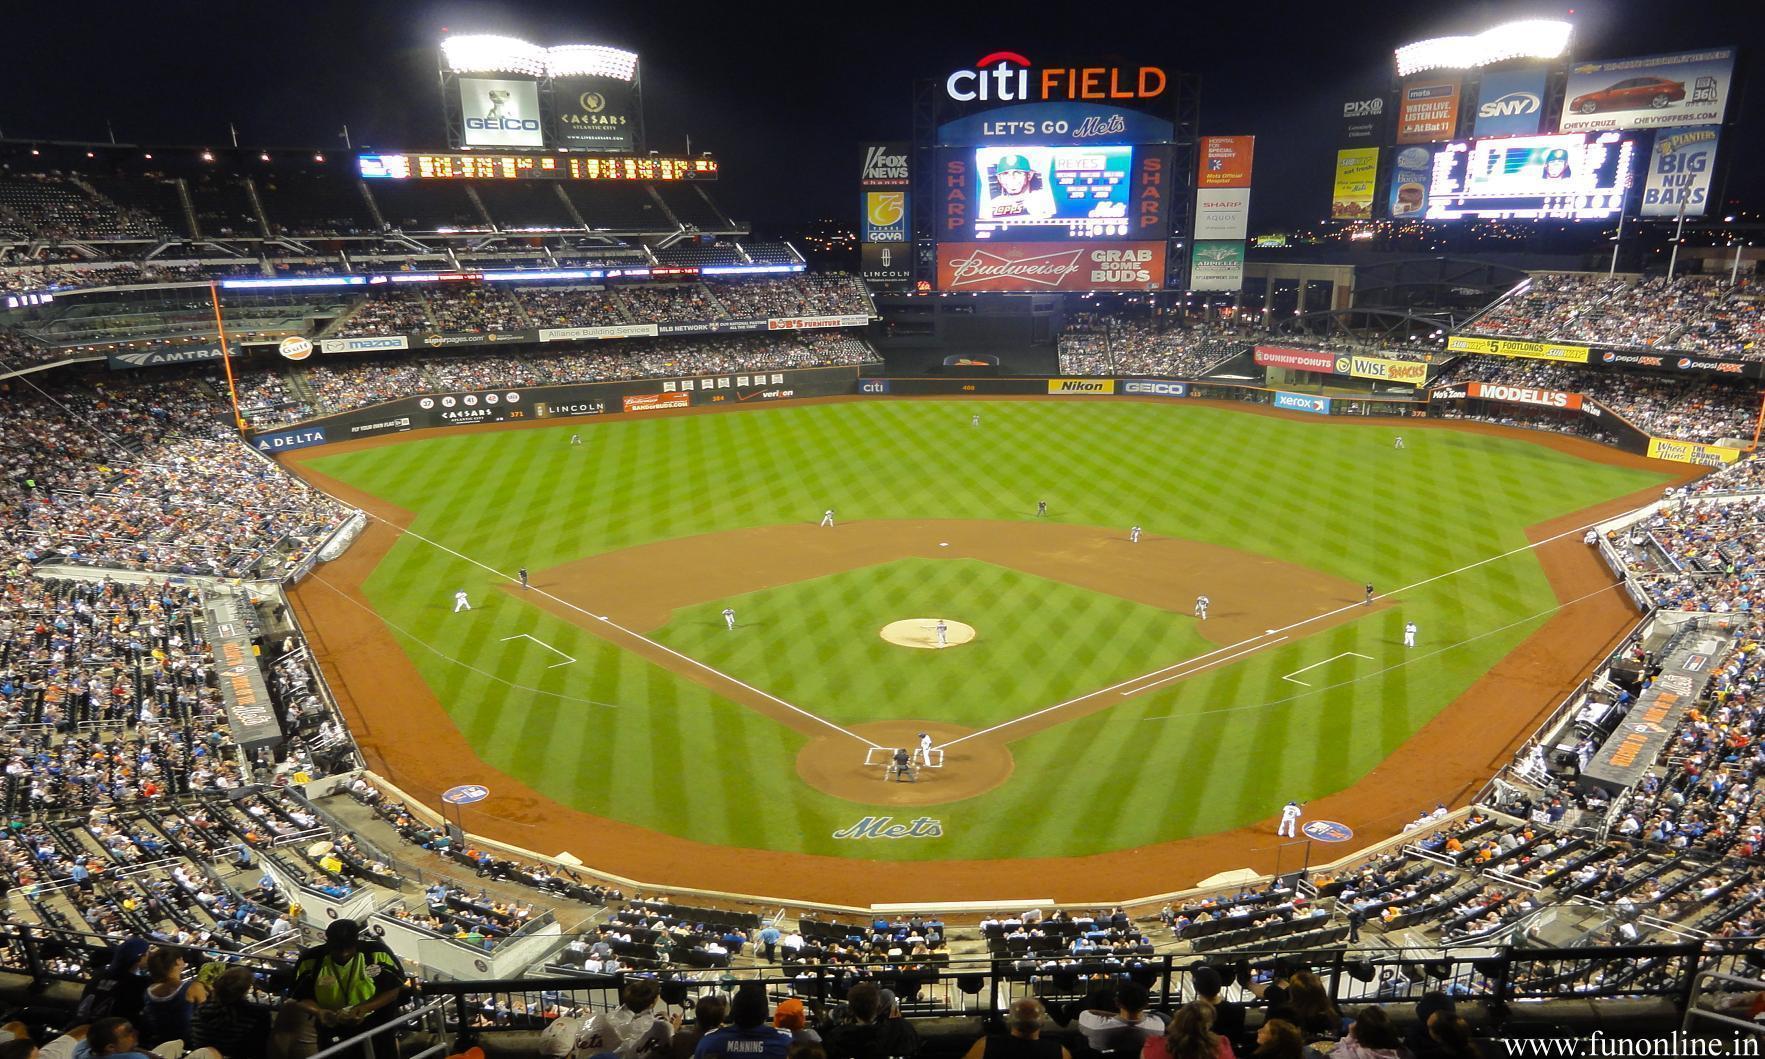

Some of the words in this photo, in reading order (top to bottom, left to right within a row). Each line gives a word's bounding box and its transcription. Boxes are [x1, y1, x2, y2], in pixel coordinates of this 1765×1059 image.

[947, 61, 1027, 101] citi
[1041, 67, 1166, 99] FIELD
[1407, 103, 1432, 113] WATCH
[1479, 99, 1530, 118] SNY
[561, 113, 627, 125] CAESARS
[1405, 111, 1431, 121] LISTEN
[1634, 112, 1718, 125] CHEVYOFFERS.COM
[467, 117, 540, 131] GEICO
[983, 121, 1036, 136] LET'S
[1041, 120, 1068, 135] GO
[1072, 114, 1125, 138] Mets
[1564, 121, 1590, 129] CHEVY
[1591, 119, 1616, 128] CRUZE
[1671, 130, 1716, 146] PLANTERS
[877, 155, 907, 167] FOX
[1058, 158, 1098, 169] REYES
[1656, 150, 1707, 175] BIG
[869, 167, 909, 179] NEWS
[1662, 173, 1697, 188] NUT
[947, 160, 966, 230] SHARP
[1141, 158, 1162, 229] SHARP
[1645, 187, 1705, 205] BARS
[870, 232, 902, 241] GOYA
[1091, 249, 1153, 262] GRAB
[949, 258, 1080, 277] Budweiser
[1101, 262, 1141, 270] SOME
[1091, 270, 1151, 283] BUDS
[674, 324, 709, 332] NETWORK
[769, 319, 804, 329] BOB'S
[549, 330, 580, 338] Alliance
[582, 329, 615, 338] Building
[617, 326, 650, 335] Services
[349, 339, 402, 350] mazda
[424, 336, 484, 345] superpages.com
[282, 341, 309, 354] Gulf
[1502, 342, 1544, 353] FOOTLONGS
[1546, 348, 1586, 360] SUBWAY
[151, 347, 236, 363] AMTRAK
[1263, 353, 1298, 365] DUNKIN'
[1297, 356, 1331, 368] DONUTS
[1615, 355, 1640, 364] pepsi
[1354, 359, 1386, 376] WISE
[1387, 363, 1424, 380] SNACKS
[1691, 360, 1717, 370] pepsi
[1061, 381, 1103, 391] Nikon
[1125, 382, 1184, 395] GEICO
[762, 388, 793, 399] verizon
[1432, 389, 1448, 399] Mo's
[1449, 390, 1466, 399] Zone
[1480, 385, 1568, 407] MODELL'S
[549, 403, 604, 413] LINCOLN
[1280, 396, 1311, 409] xerox
[441, 408, 492, 419] CAESARS
[373, 422, 384, 430] OWN
[274, 432, 324, 447] DELTA
[1657, 441, 1687, 453] Wheat
[1656, 449, 1686, 461] Thins
[1690, 451, 1721, 461] CRUNCH
[832, 816, 943, 839] Mets
[727, 1040, 764, 1054] MANNING
